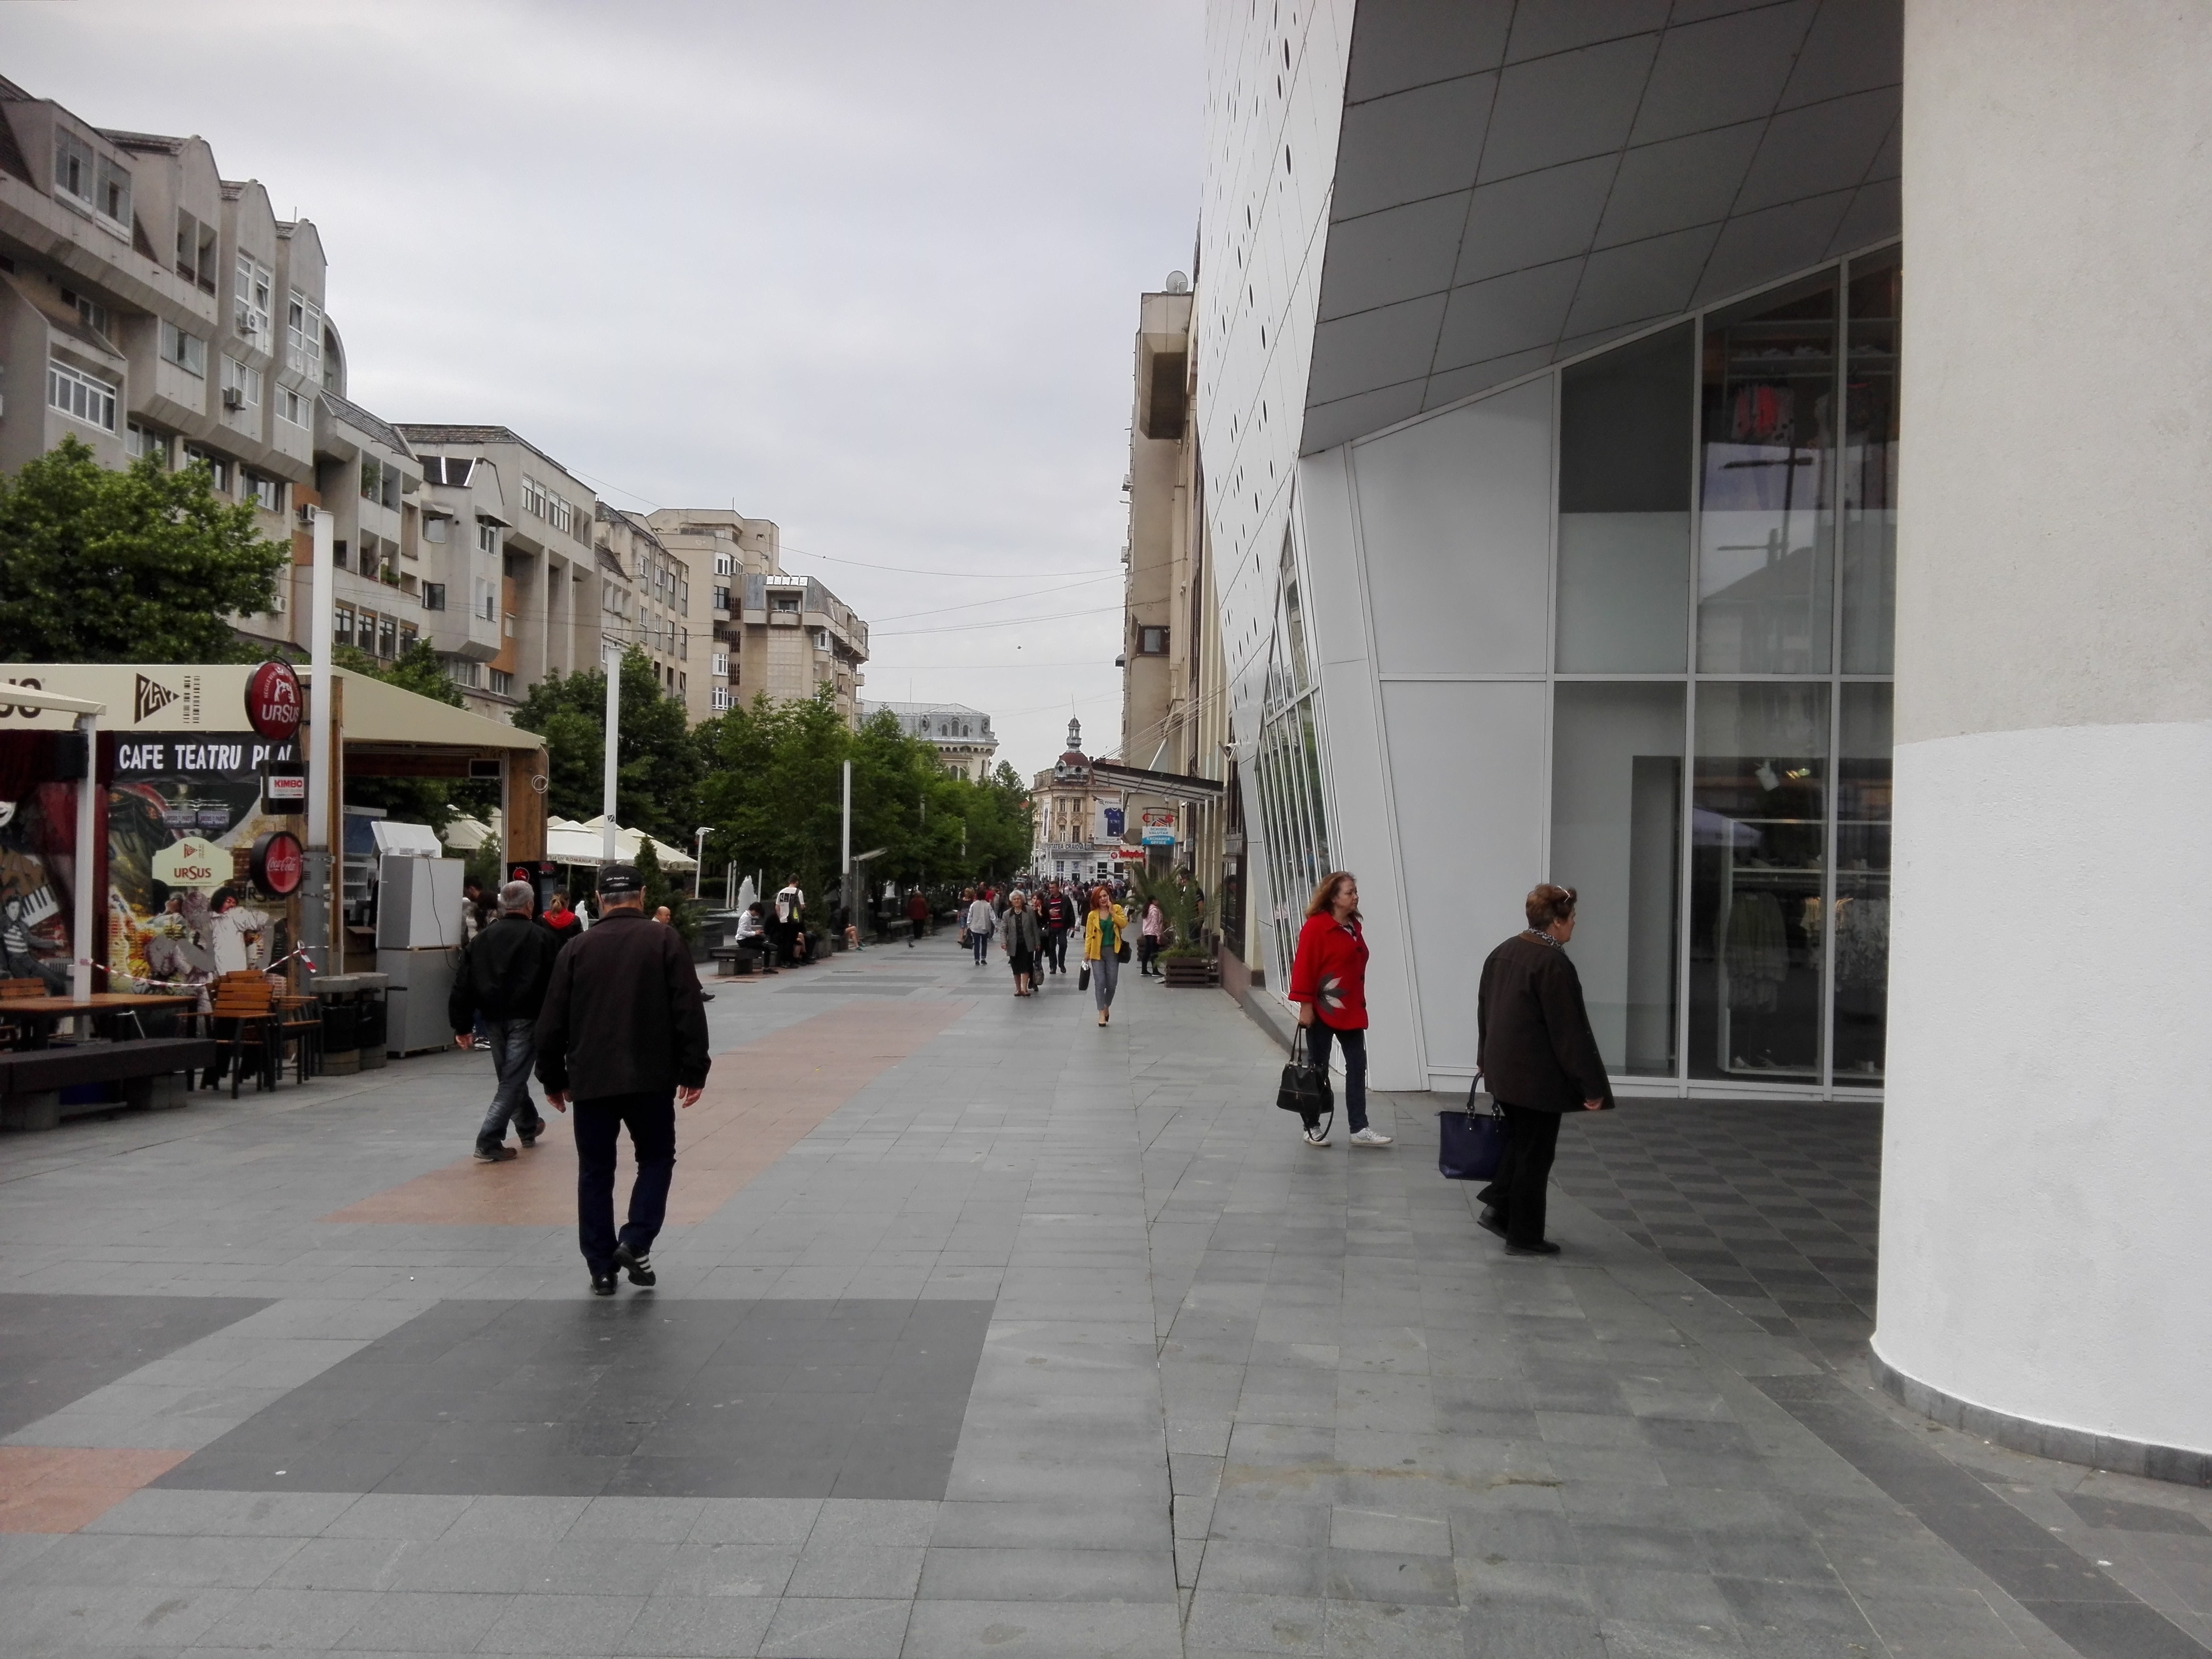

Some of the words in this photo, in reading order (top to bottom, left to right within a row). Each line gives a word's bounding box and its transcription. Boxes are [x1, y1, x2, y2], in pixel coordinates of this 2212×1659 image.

[262, 704, 299, 723] URSUS
[119, 744, 164, 769] CAFE
[175, 744, 242, 769] TEATRU
[174, 866, 212, 880] URSUS
